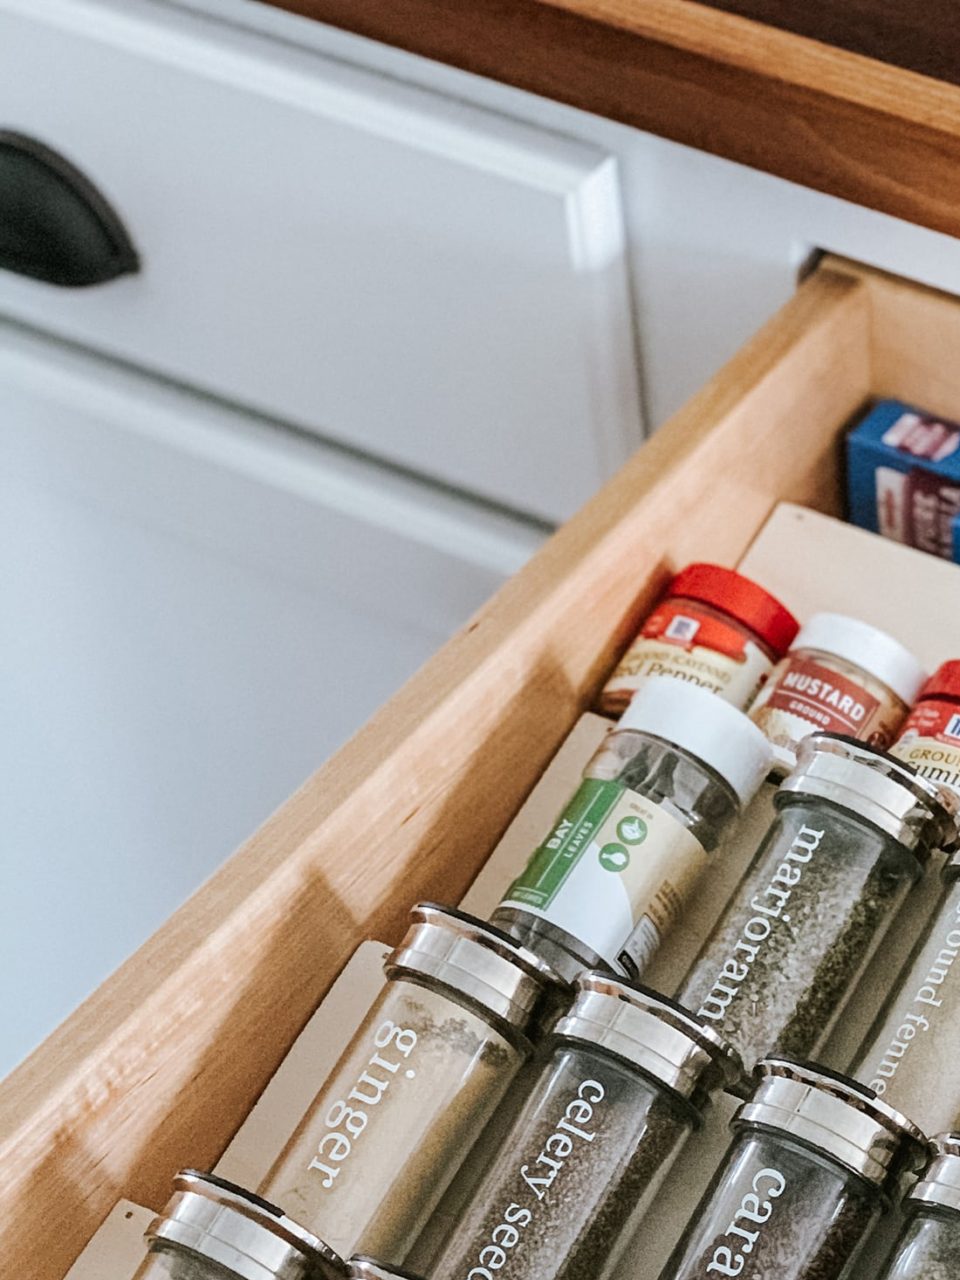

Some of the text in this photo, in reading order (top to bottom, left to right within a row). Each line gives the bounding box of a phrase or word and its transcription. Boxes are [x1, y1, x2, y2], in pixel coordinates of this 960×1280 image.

[782, 671, 866, 721] MUSTARD
[546, 819, 574, 850] BAY
[563, 820, 594, 859] LEAVES
[697, 823, 825, 1021] marjoram
[868, 1012, 930, 1096] fenne
[306, 1019, 418, 1189] ginger
[520, 1079, 605, 1201] celery
